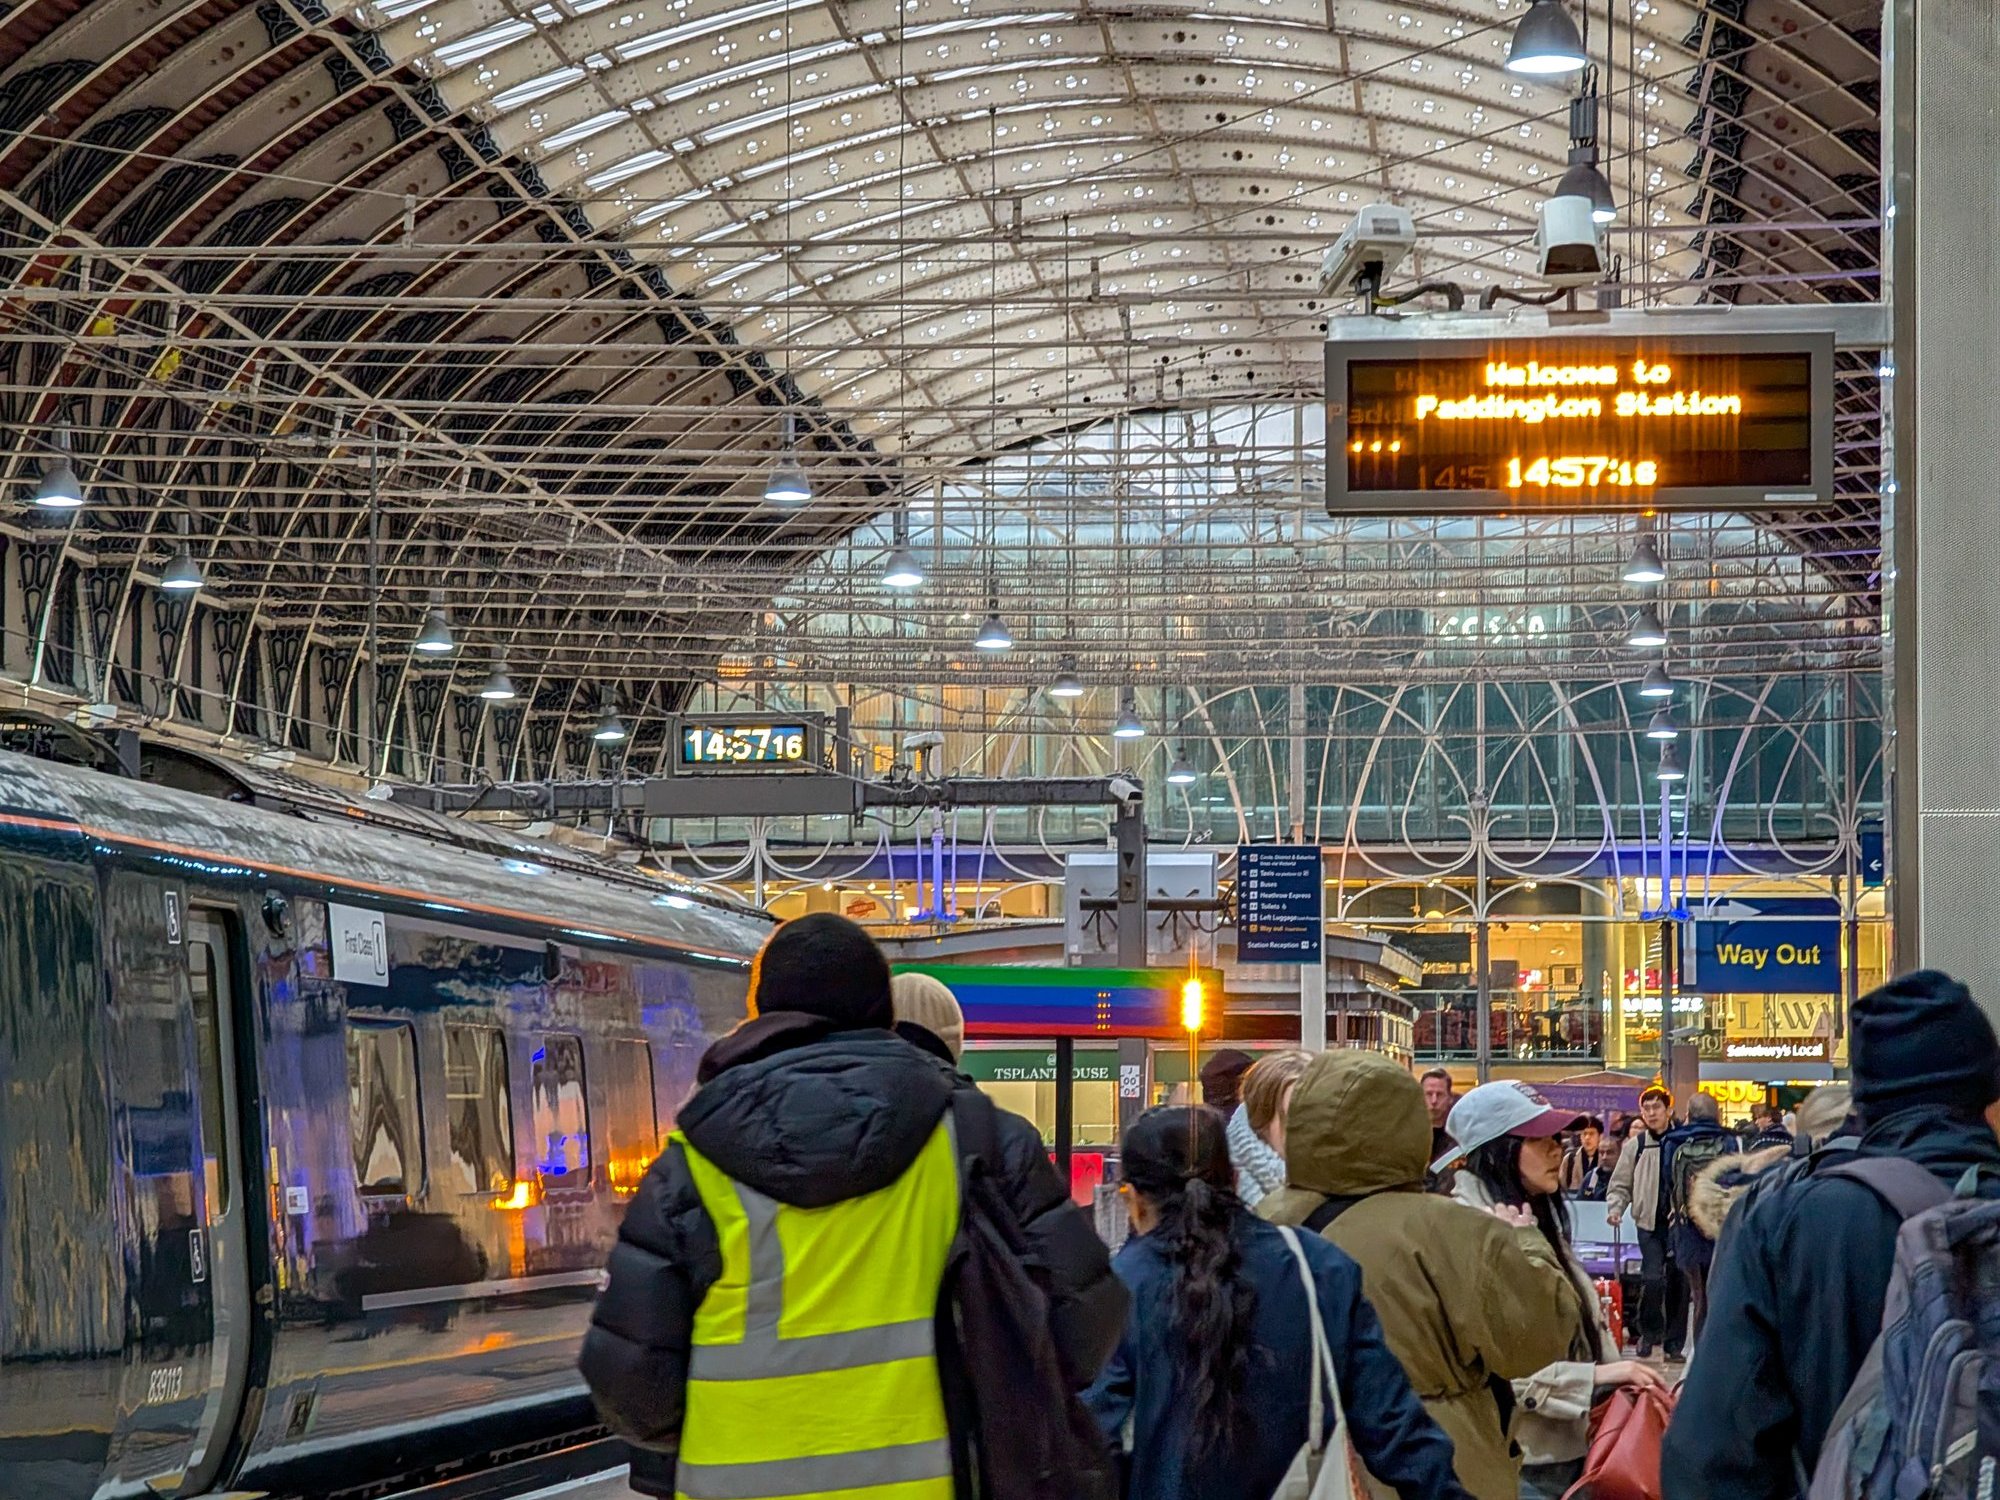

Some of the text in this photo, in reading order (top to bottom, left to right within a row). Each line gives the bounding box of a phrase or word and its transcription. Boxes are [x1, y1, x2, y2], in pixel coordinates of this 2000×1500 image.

[1485, 359, 1671, 386] Welcome to
[1415, 389, 1741, 423] Paddington Station
[688, 728, 803, 761] 14:57 16
[1260, 902, 1280, 910] Toilets
[1288, 892, 1312, 900] Express
[1272, 914, 1297, 922] Luggage
[344, 929, 358, 954] First
[358, 931, 373, 956] Class
[1247, 941, 1299, 950] Station Reception
[1716, 943, 1821, 970] Way Out
[1792, 1042, 1824, 1057] Local
[148, 1366, 183, 1404] 839113
